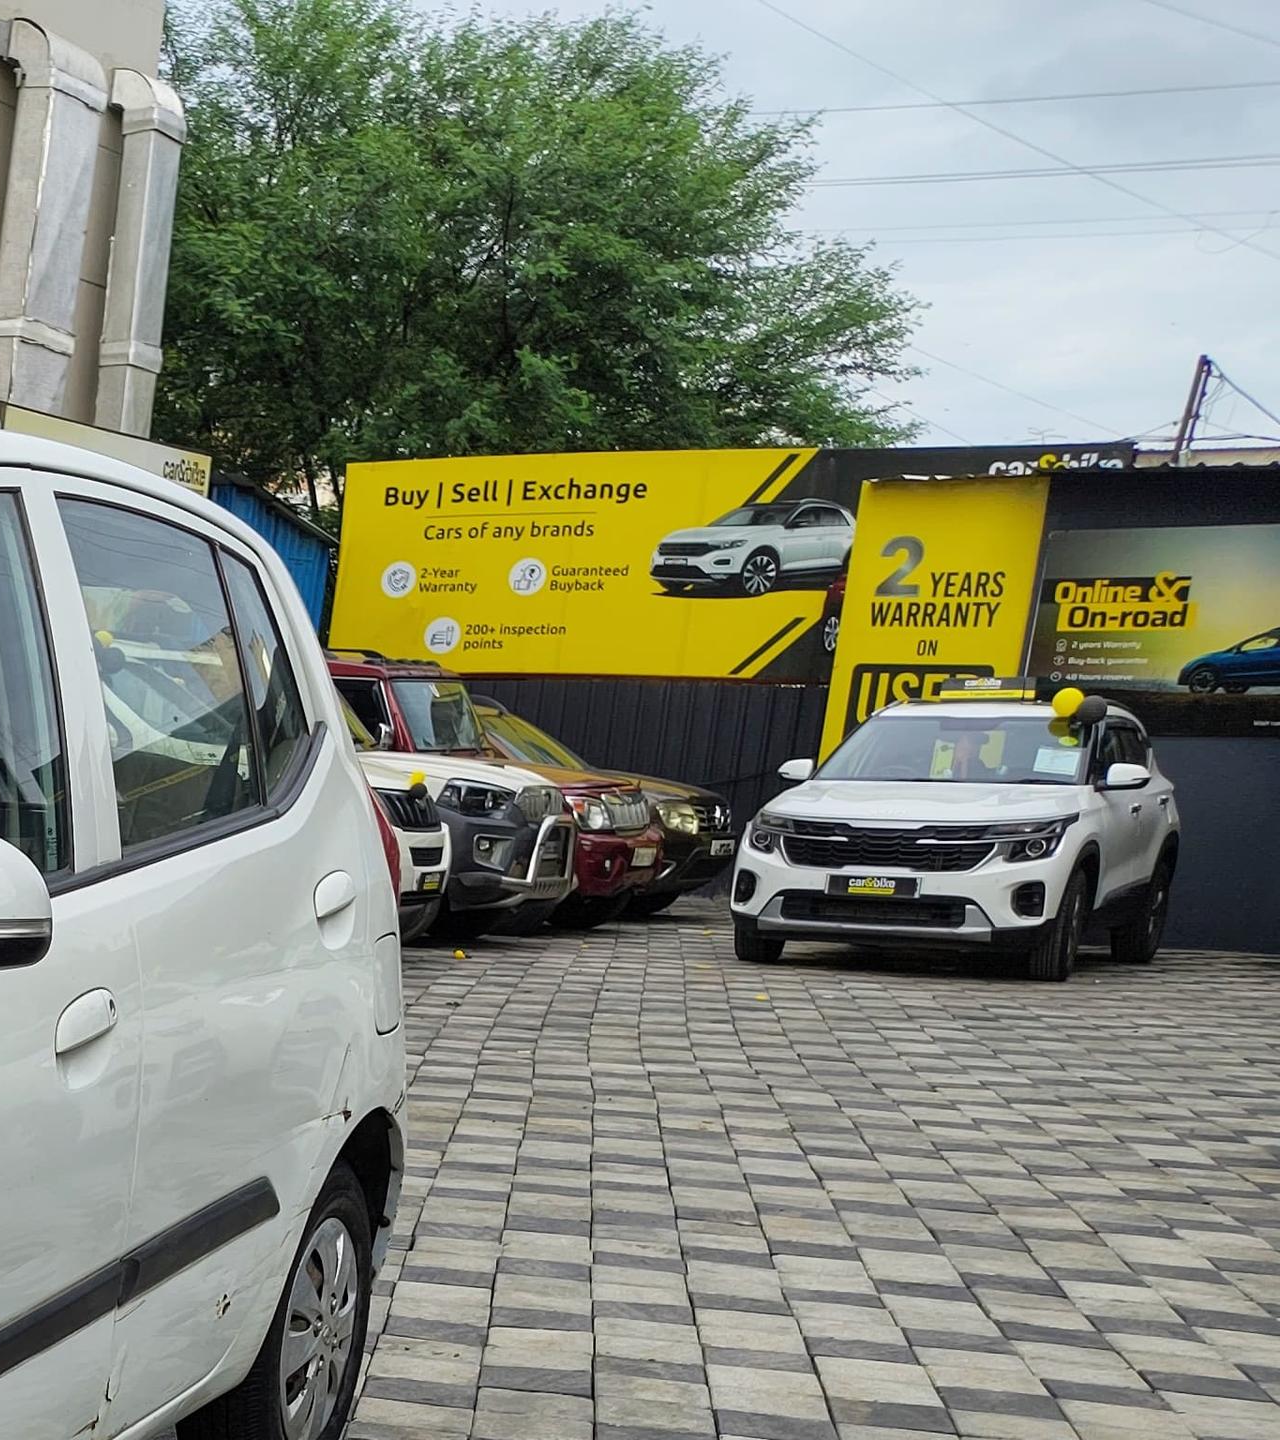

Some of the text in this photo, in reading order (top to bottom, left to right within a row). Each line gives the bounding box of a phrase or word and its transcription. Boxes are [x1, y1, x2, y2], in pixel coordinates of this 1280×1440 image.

[163, 459, 206, 486] car&bike
[384, 478, 648, 509] Buy Sell Exchange
[424, 520, 595, 541] Cars of any brands
[420, 567, 461, 579] 2-Year
[552, 565, 629, 577] Guaranteed
[874, 535, 1006, 598] 2 YEARS
[419, 581, 477, 595] Warranty
[550, 579, 605, 592] Buyback
[1054, 570, 1192, 604] Online &
[871, 601, 1001, 628] WARRANTY
[1067, 603, 1189, 629] On-road
[465, 623, 567, 638] 200+ inspection
[463, 638, 504, 651] points
[916, 639, 938, 656] ON
[856, 671, 980, 724] USE
[848, 877, 896, 888] car&bike
